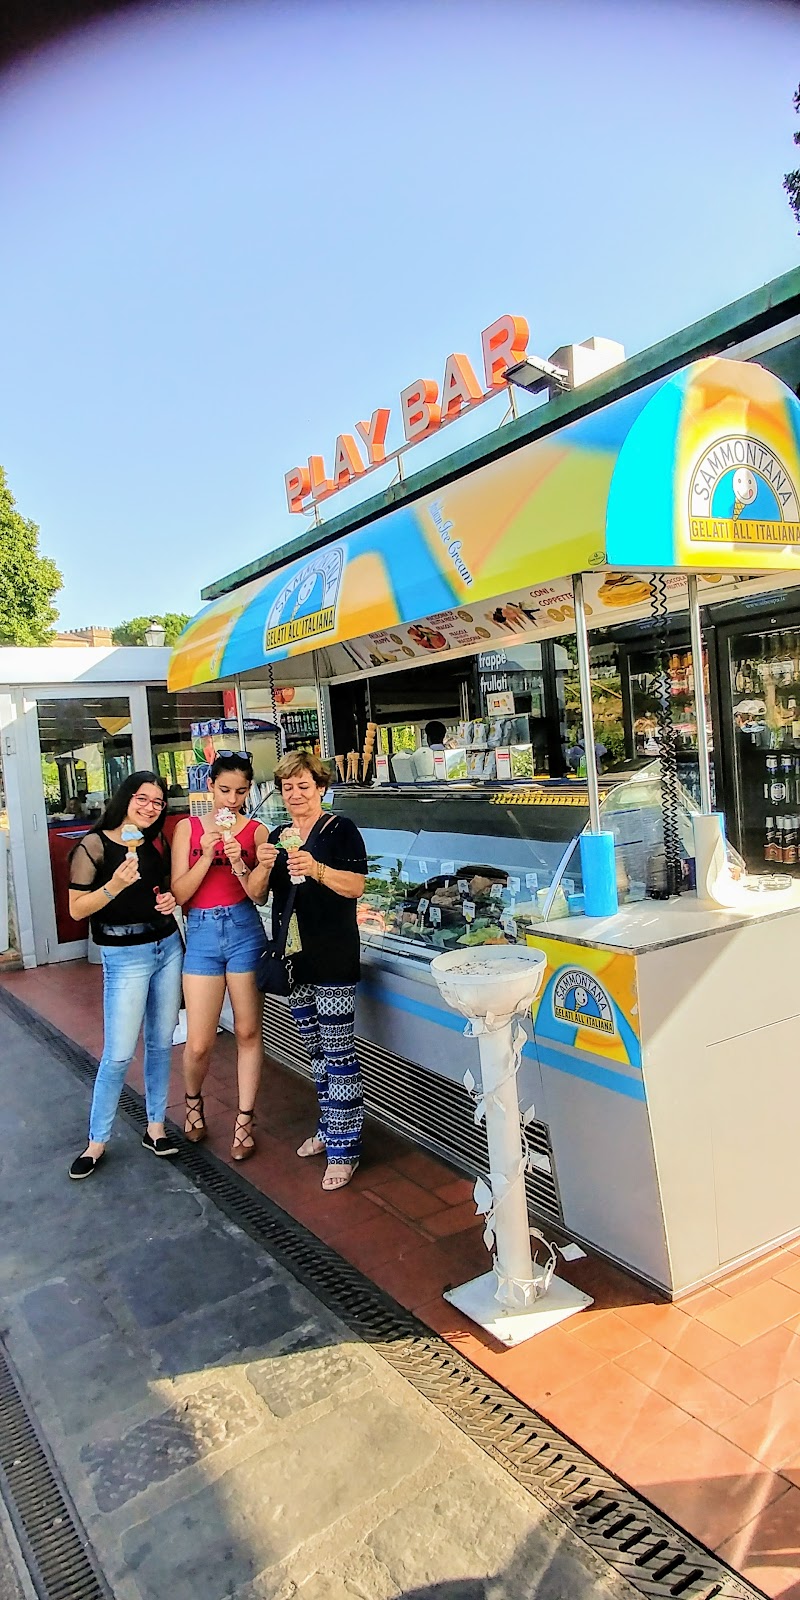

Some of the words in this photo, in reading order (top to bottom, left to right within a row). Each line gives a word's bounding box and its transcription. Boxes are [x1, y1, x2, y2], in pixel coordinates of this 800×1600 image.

[284, 408, 391, 513] PLAY
[400, 314, 529, 441] BAR
[694, 440, 793, 506] SAMMONTANA
[691, 520, 729, 538] GELATI
[439, 520, 453, 543] Ice
[448, 541, 473, 585] Cream
[530, 588, 549, 598] CONI
[538, 592, 575, 607] COPPETTE
[266, 626, 287, 646] GELATI
[478, 648, 507, 671] frappè
[480, 672, 508, 693] frullati
[556, 973, 608, 1011] SAMMONTANA
[555, 1007, 574, 1020] GELATI
